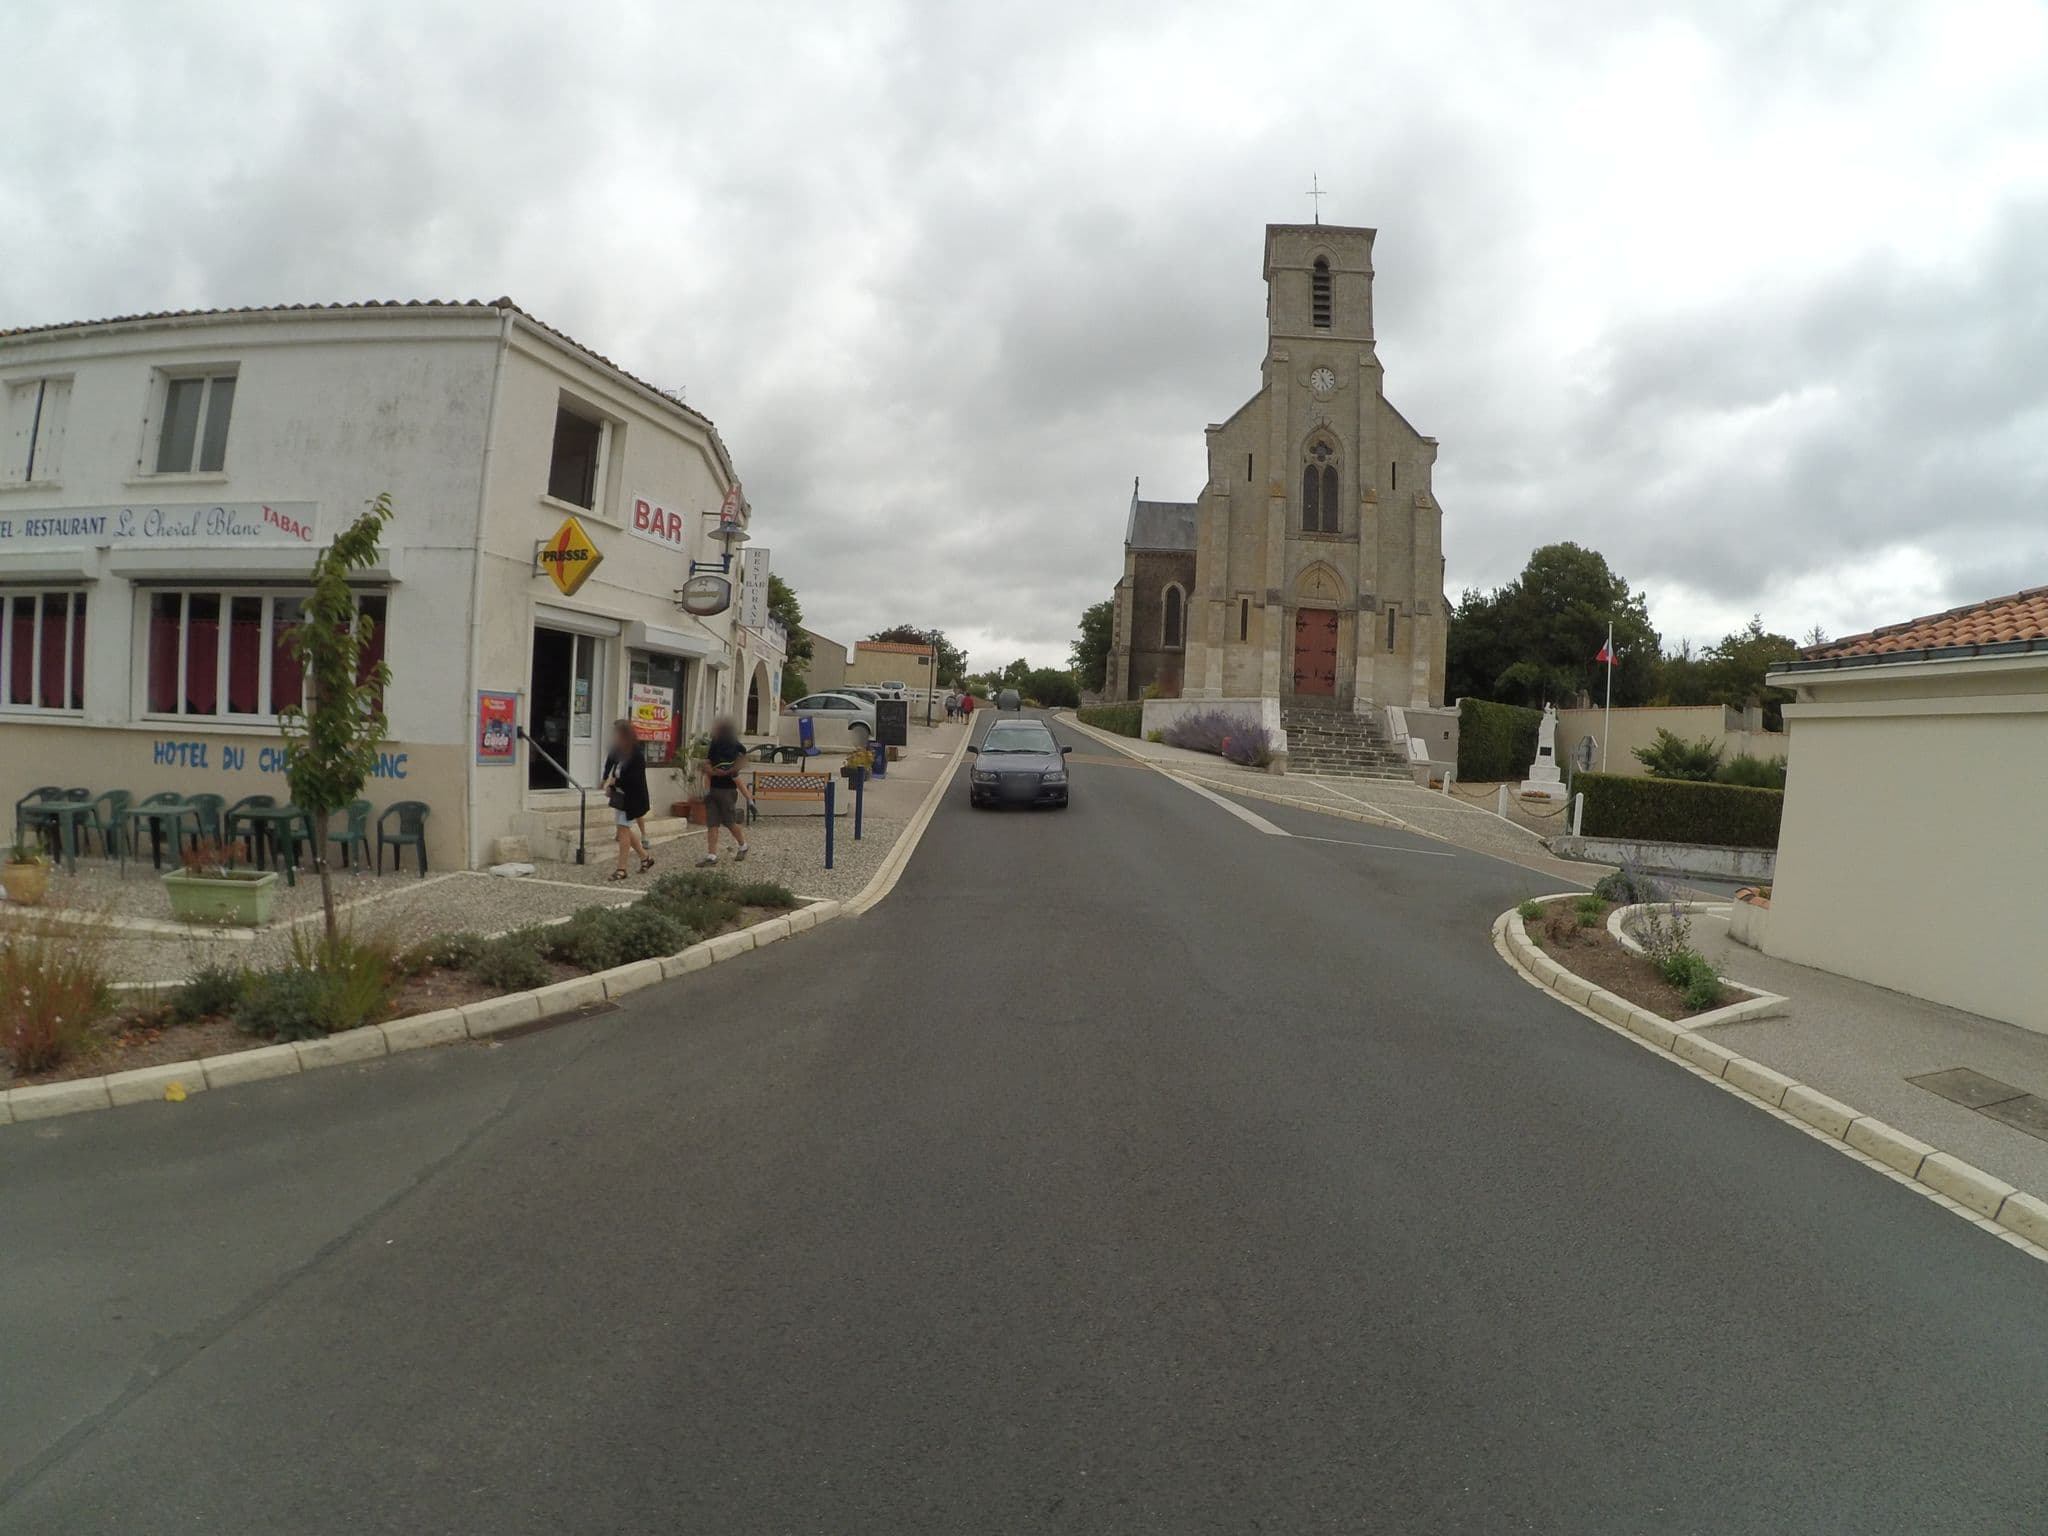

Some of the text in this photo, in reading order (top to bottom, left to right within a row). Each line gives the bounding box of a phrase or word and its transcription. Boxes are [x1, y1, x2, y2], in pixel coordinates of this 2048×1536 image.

[25, 516, 107, 537] RESTAURANT
[113, 505, 262, 537] Le Cheval Blanc
[262, 505, 313, 542] TABAC
[635, 499, 683, 544] BAR
[542, 549, 588, 562] PRESSE
[154, 741, 208, 768] HOTEL
[223, 746, 245, 770] DU
